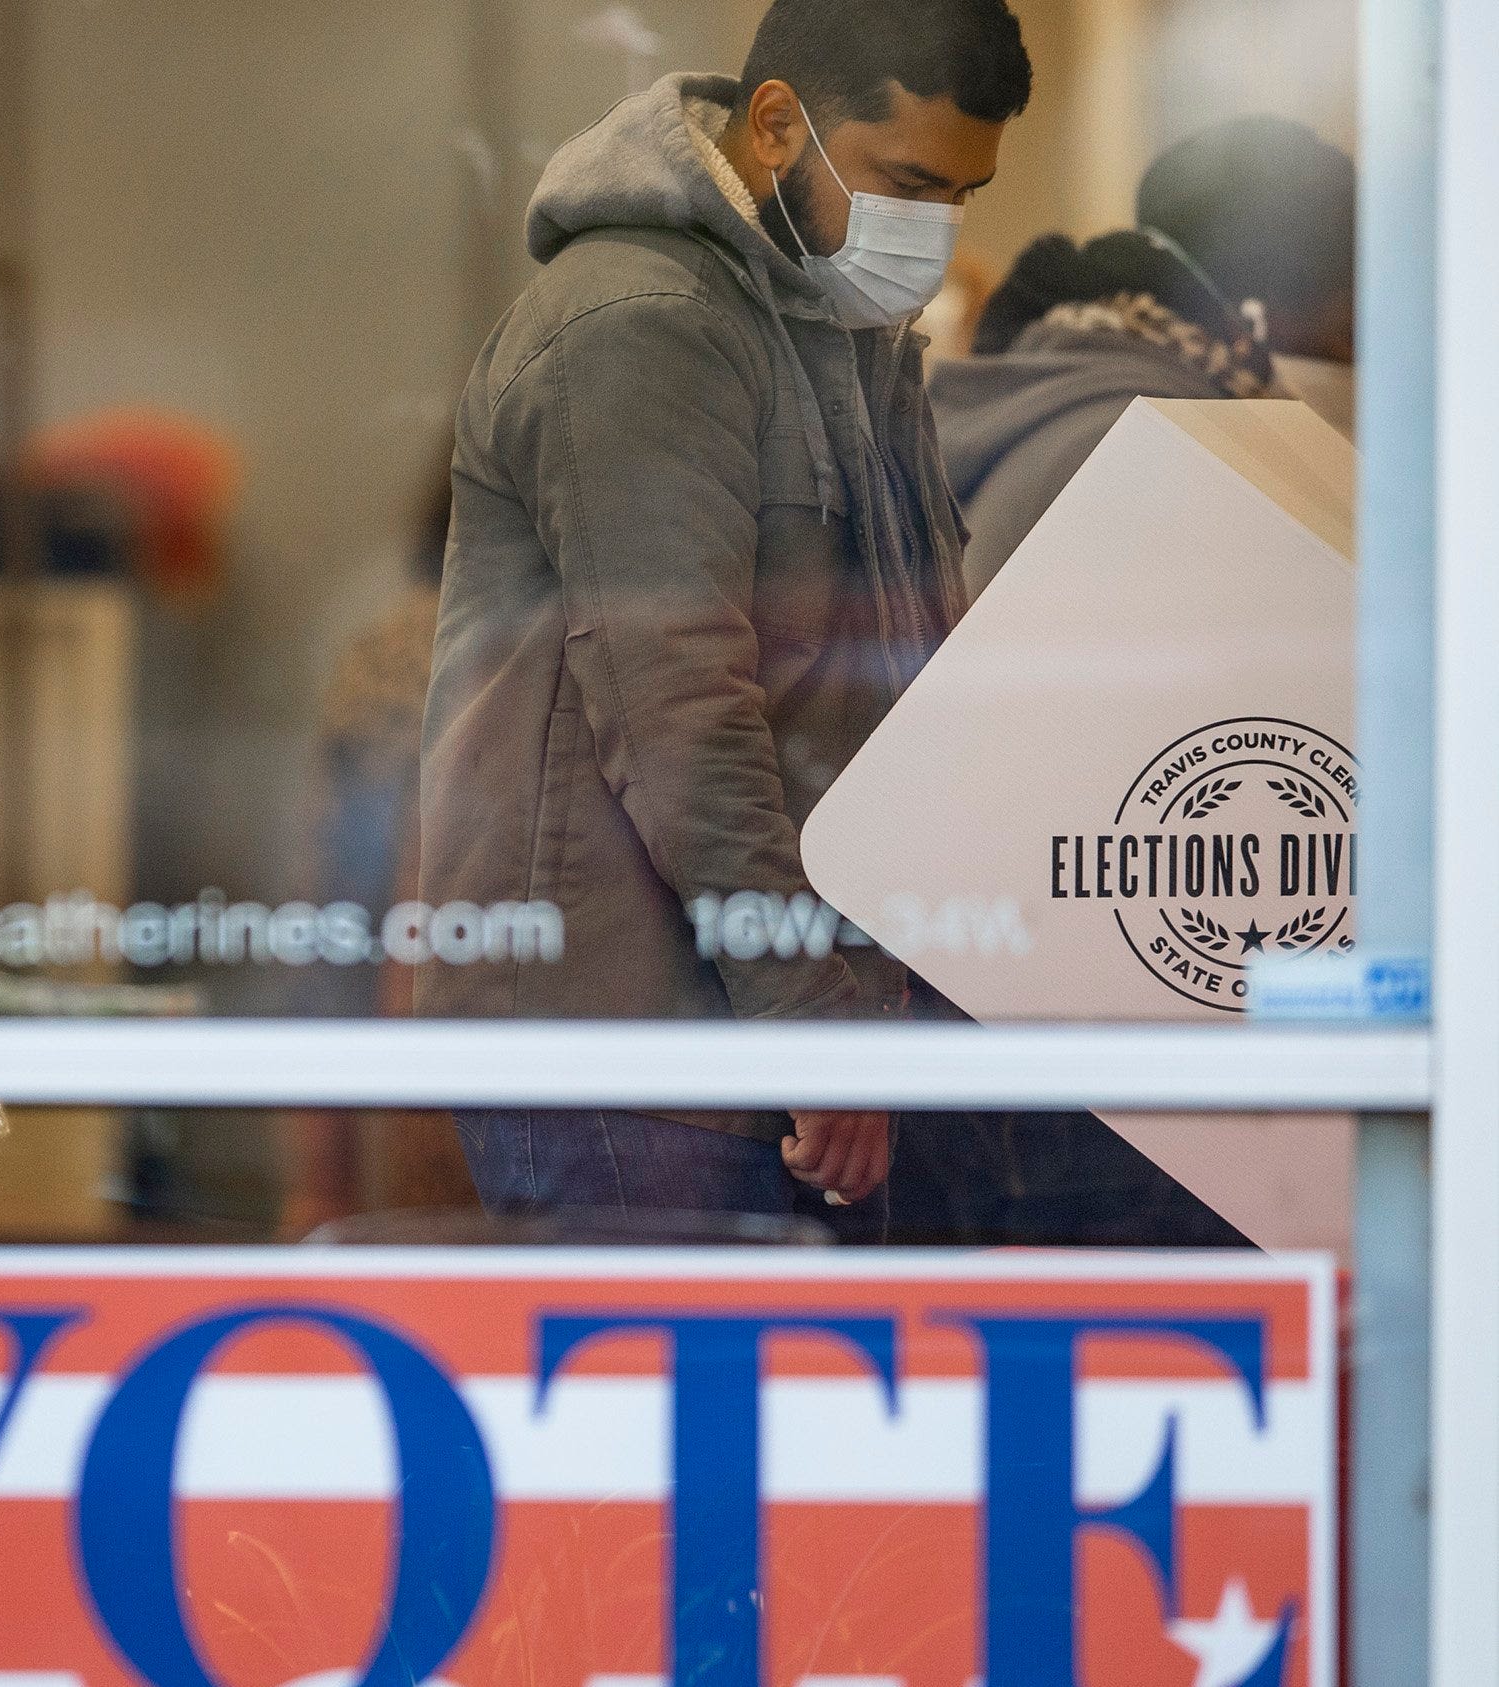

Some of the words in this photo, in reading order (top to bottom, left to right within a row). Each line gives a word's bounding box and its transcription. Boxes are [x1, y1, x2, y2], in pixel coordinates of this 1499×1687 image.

[1141, 746, 1207, 806] TRAVIS
[1211, 732, 1307, 756] COUNTY
[1051, 834, 1260, 899] ELECTIONS
[1150, 936, 1223, 993] STATE
